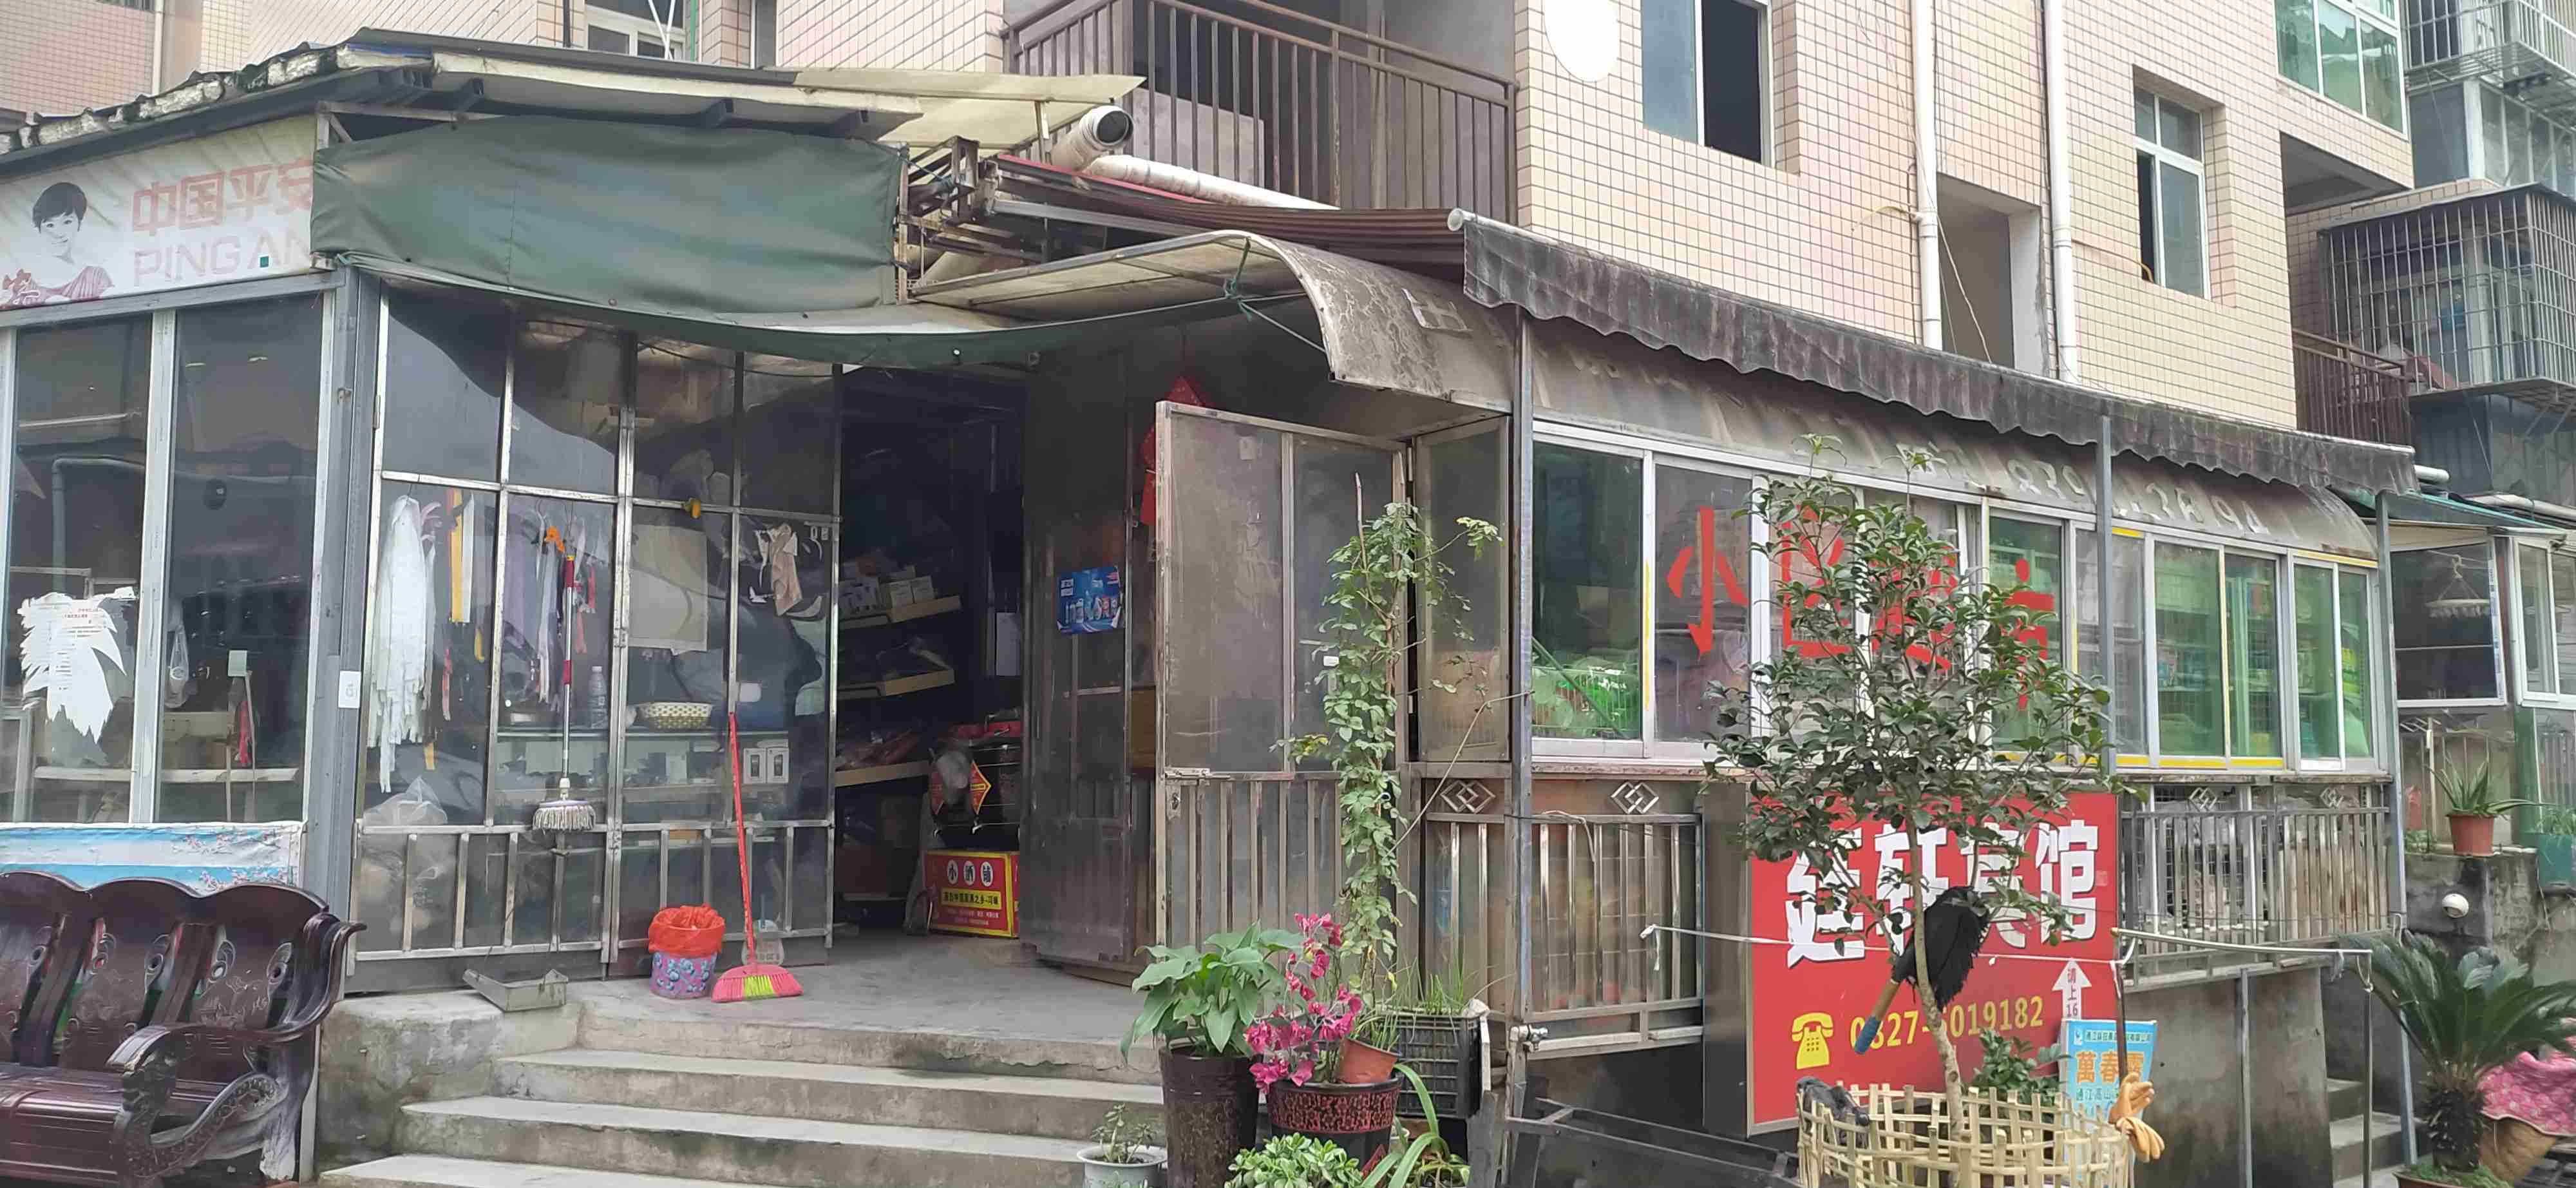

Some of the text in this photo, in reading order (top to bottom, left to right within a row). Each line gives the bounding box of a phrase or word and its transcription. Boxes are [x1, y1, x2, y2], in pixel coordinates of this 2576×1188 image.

[133, 158, 312, 236] 中国平安
[1850, 995, 2043, 1050] 027-019182
